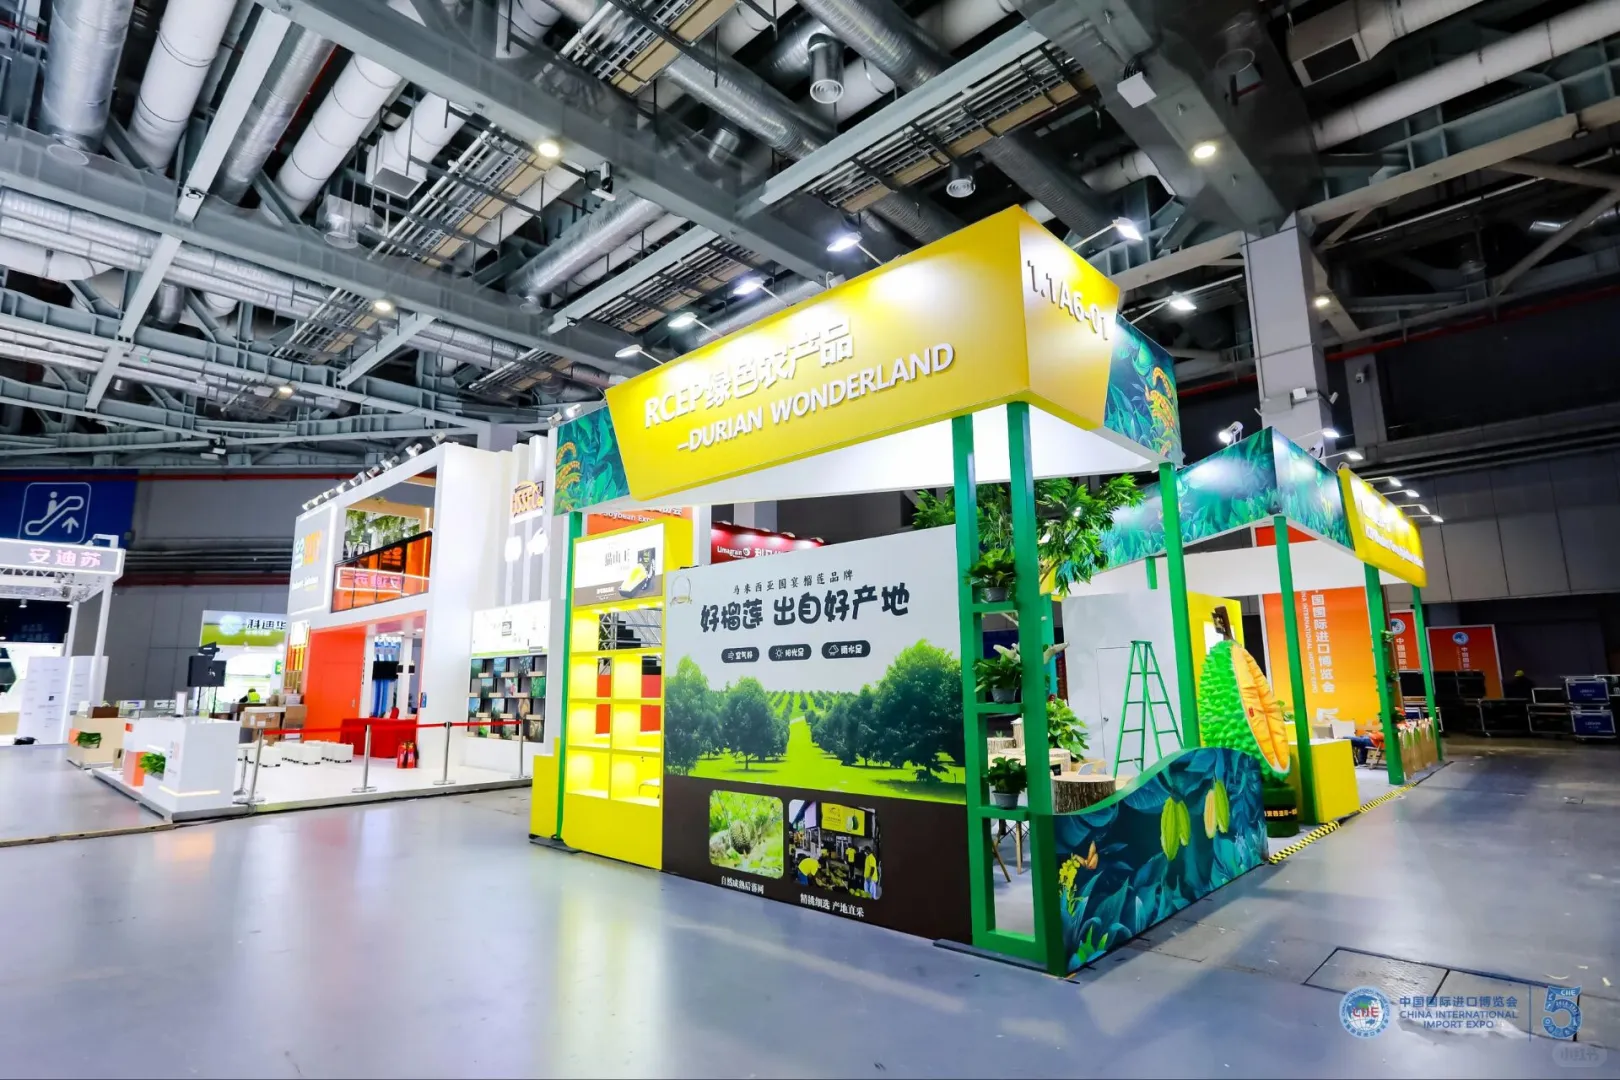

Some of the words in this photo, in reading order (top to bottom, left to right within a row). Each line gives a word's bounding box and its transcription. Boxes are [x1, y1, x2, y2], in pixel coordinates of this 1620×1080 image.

[1027, 258, 1109, 341] 1.1A6-01
[643, 316, 856, 428] RCEP绿色农产品
[771, 342, 956, 425] WONDERLAND
[28, 547, 102, 568] 安迪苏
[716, 546, 743, 557] Limagrain
[700, 597, 764, 633] 好榴莲
[773, 582, 910, 626] 出自好产地
[732, 569, 854, 595] 马来西亚国宴榴莲品牌
[1311, 592, 1335, 693] 国国际进口博览会
[832, 902, 865, 918] 产地直采
